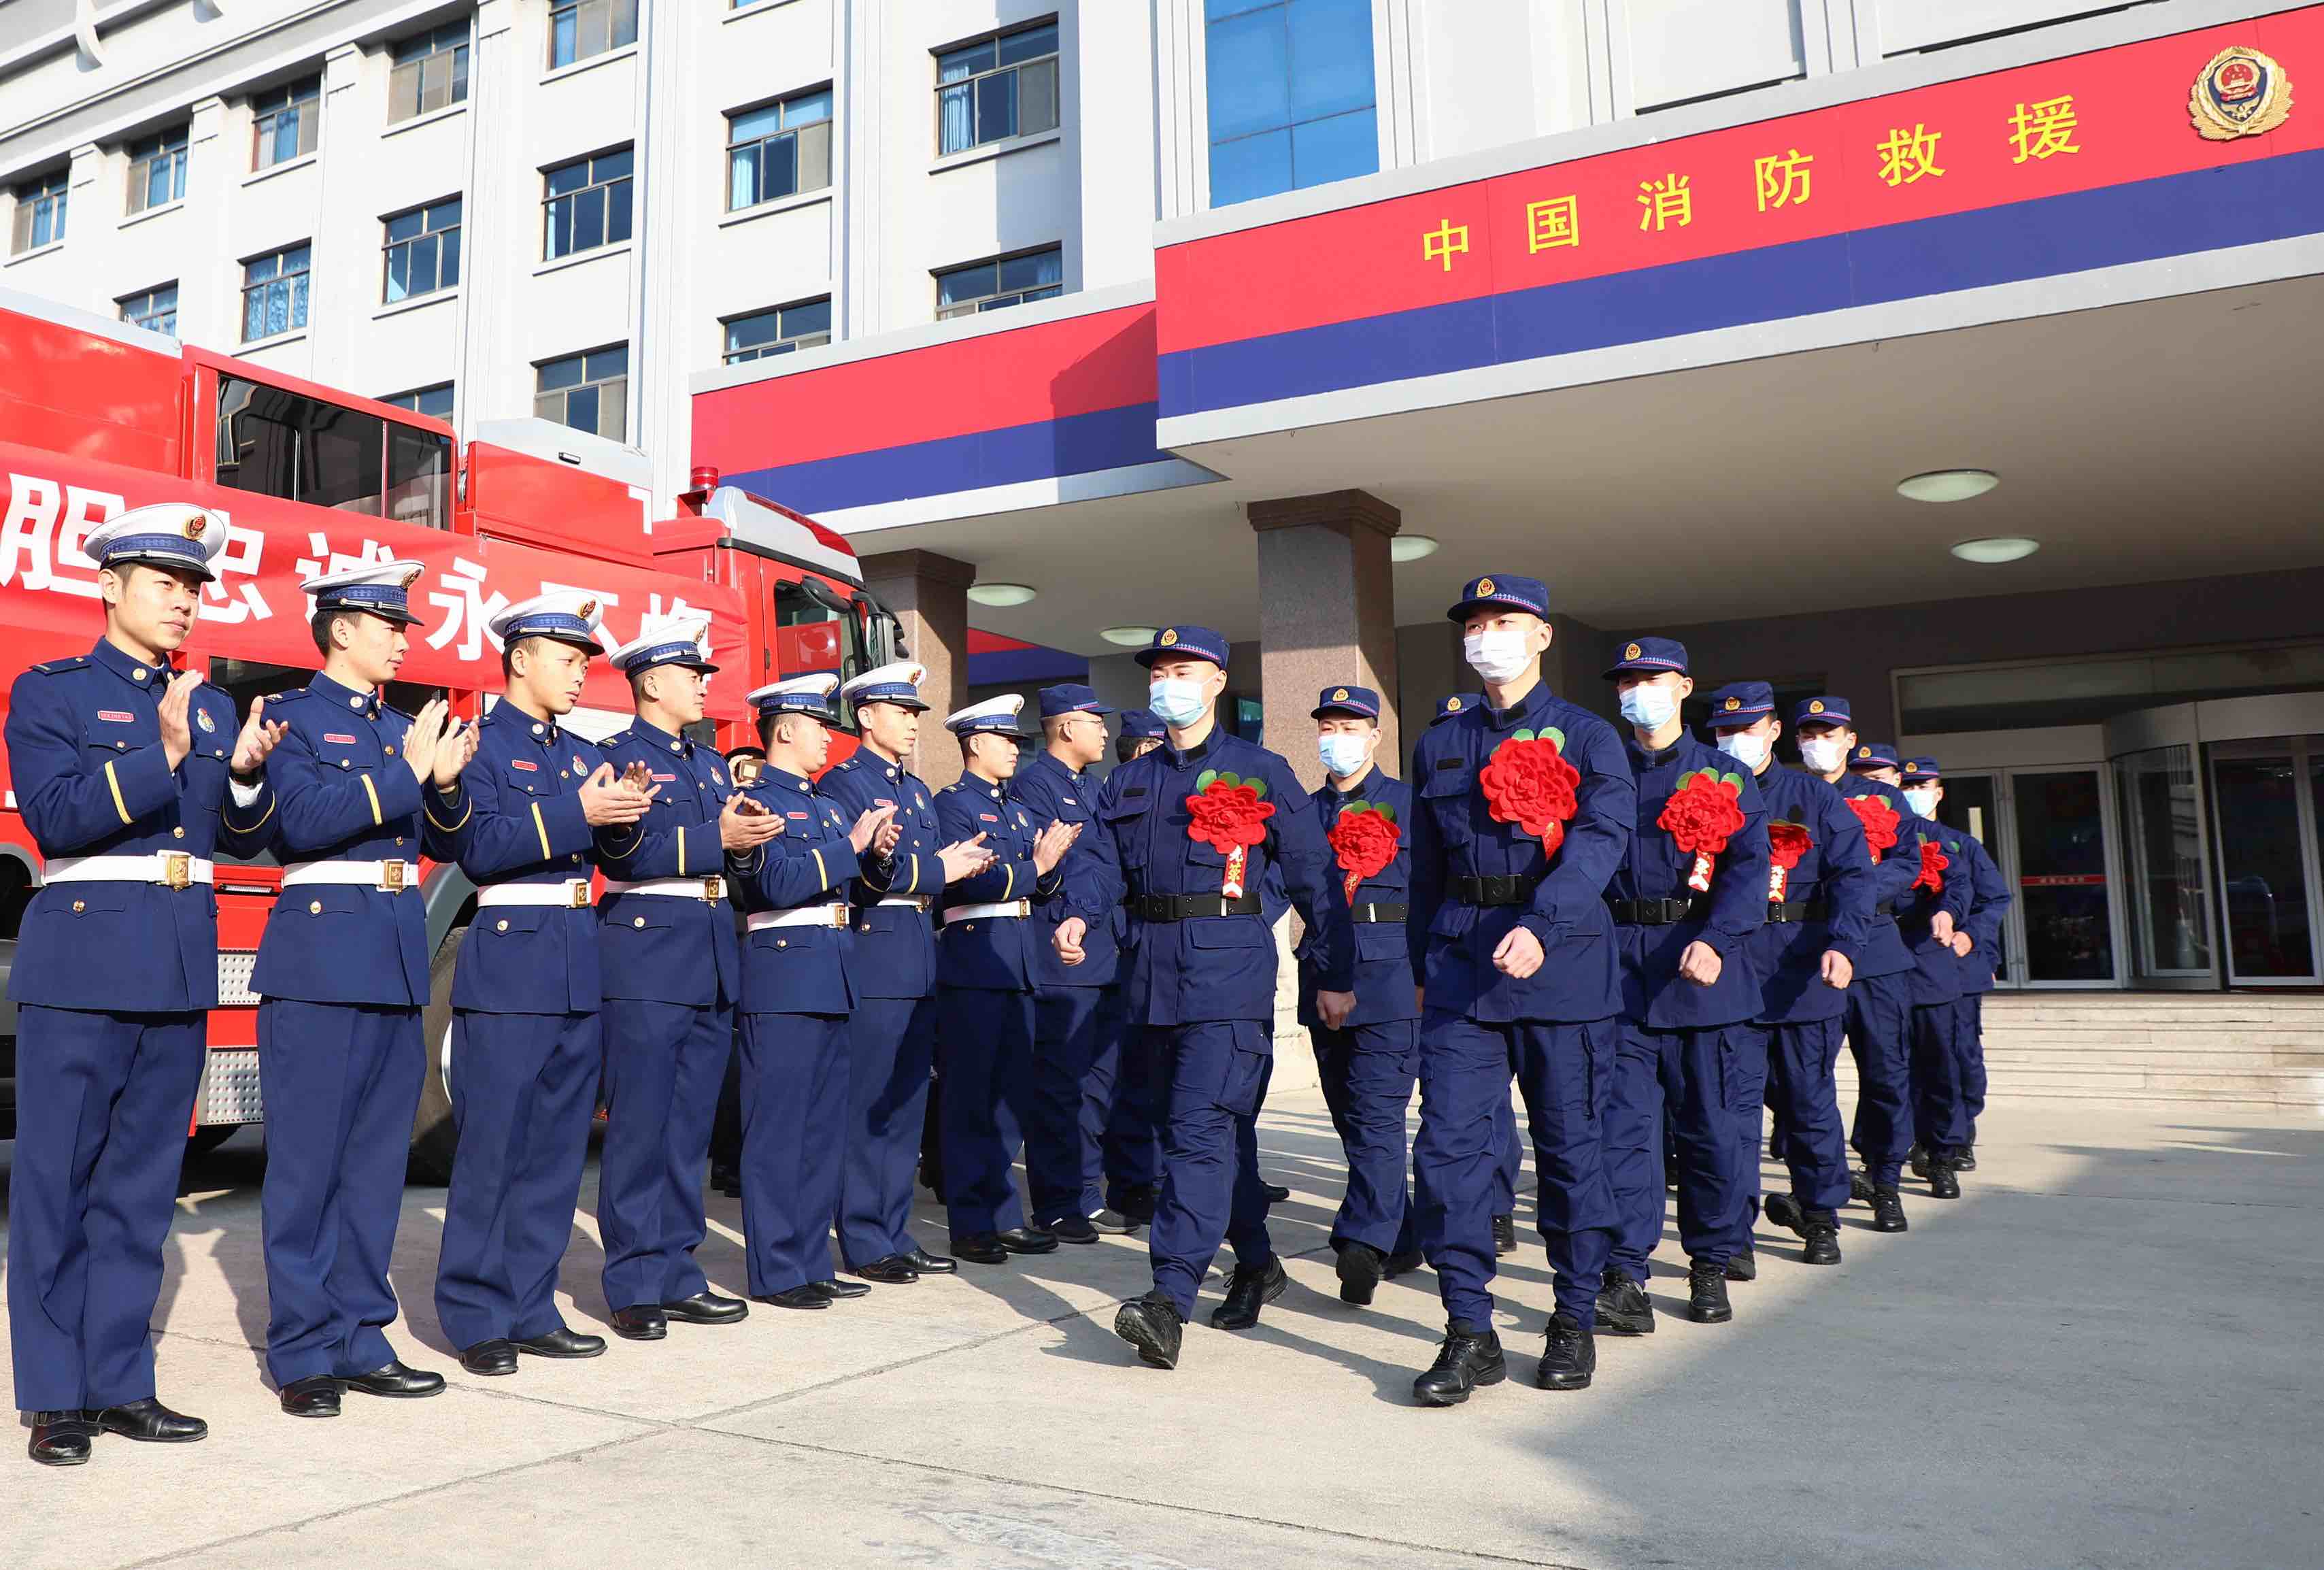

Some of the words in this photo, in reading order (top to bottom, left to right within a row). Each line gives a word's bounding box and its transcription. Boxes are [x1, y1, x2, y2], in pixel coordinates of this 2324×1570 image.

[1423, 95, 2080, 270] 中国消防救援
